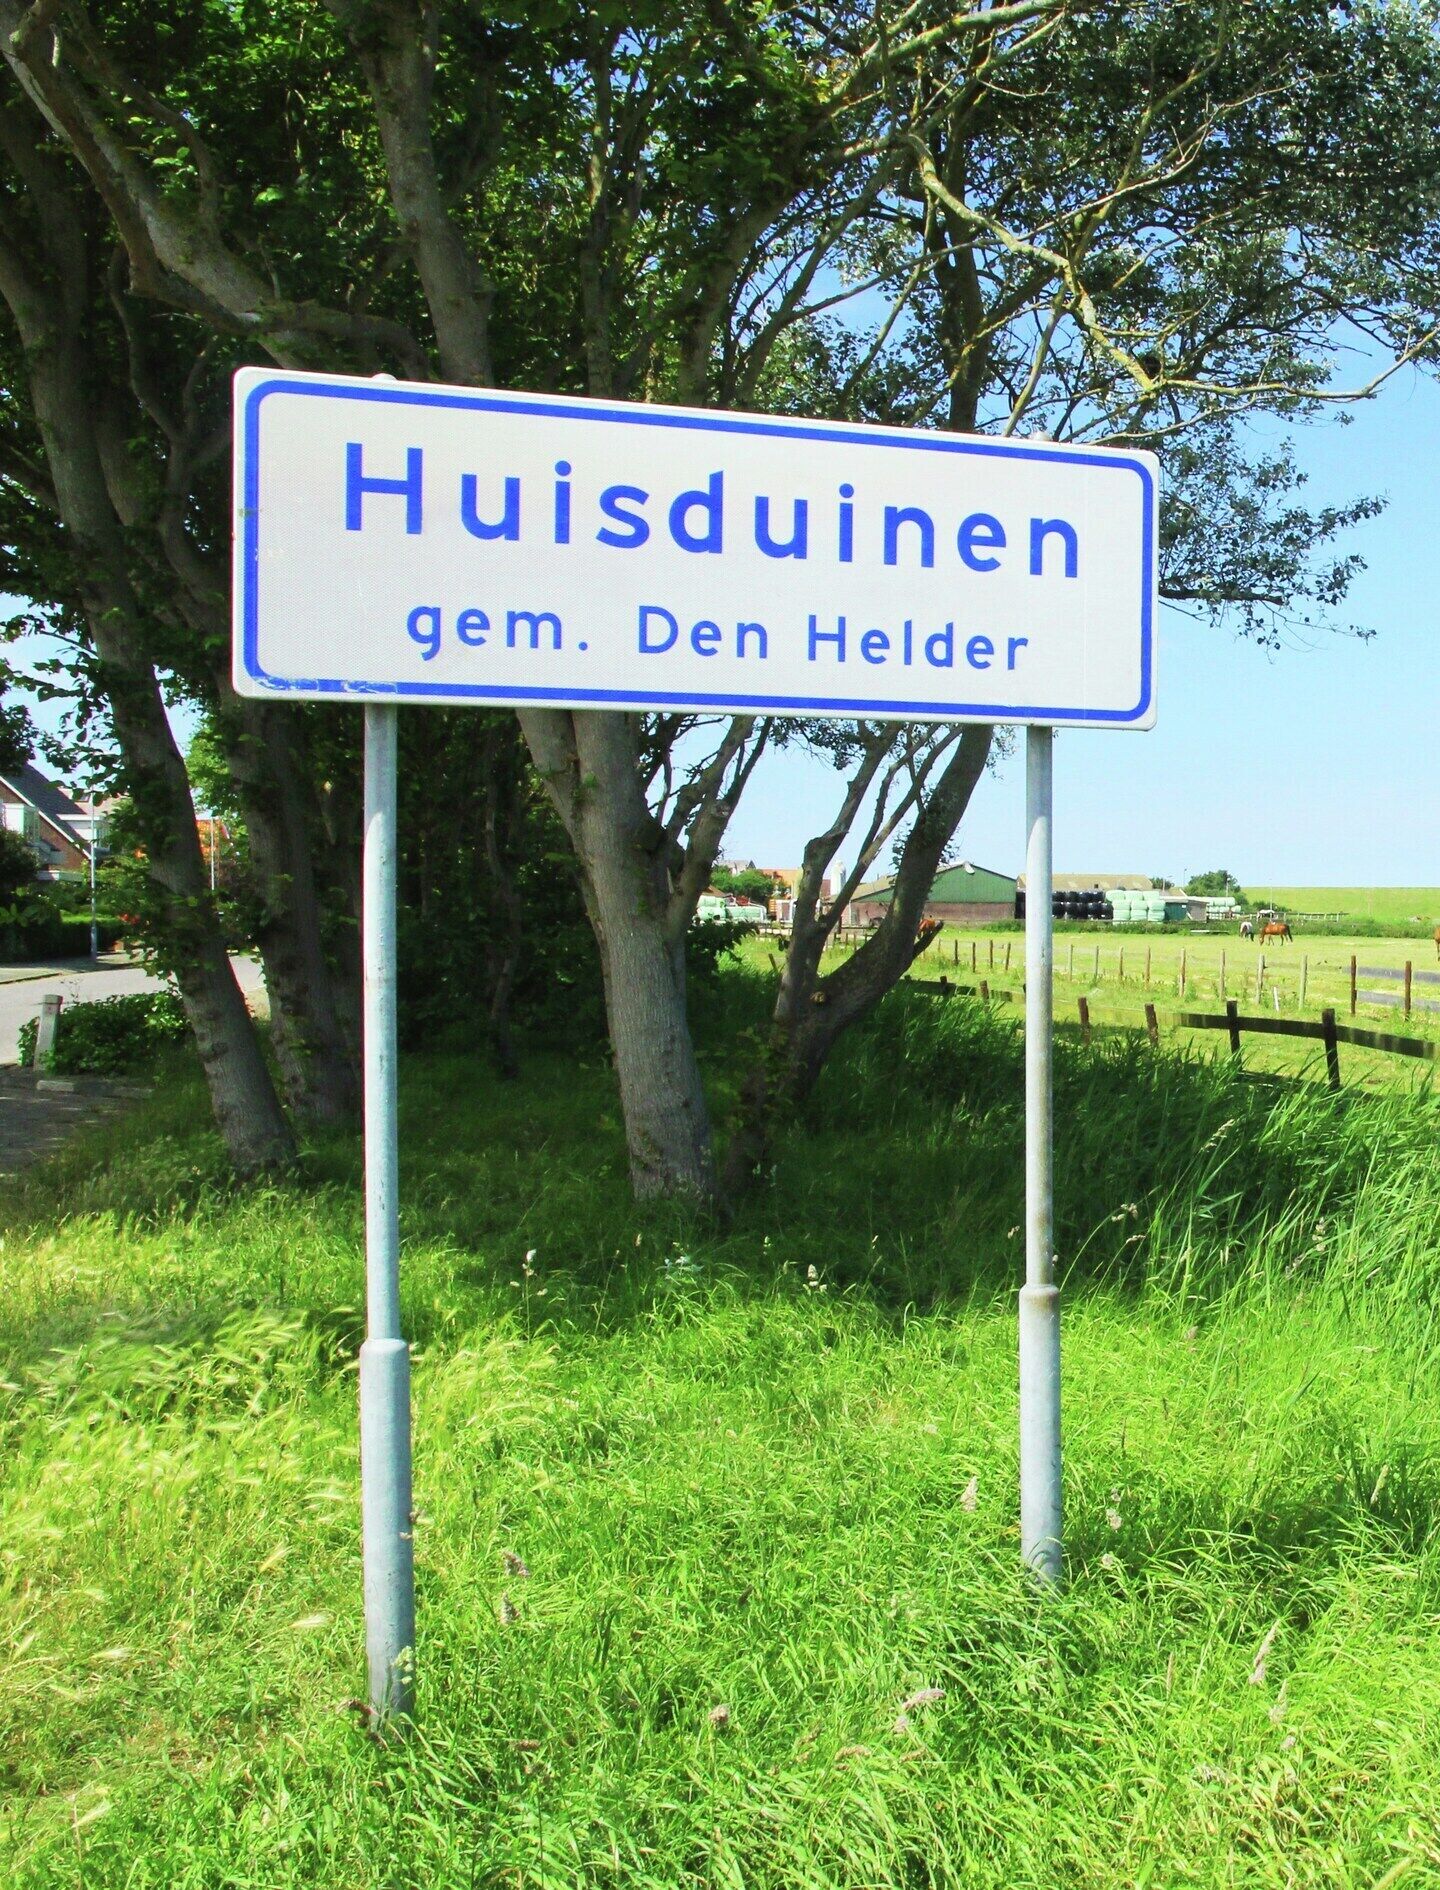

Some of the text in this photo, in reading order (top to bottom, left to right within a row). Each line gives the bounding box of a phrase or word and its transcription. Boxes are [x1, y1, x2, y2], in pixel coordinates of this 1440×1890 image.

[344, 441, 1079, 579] Huisduinen
[405, 604, 1029, 671] gem. Den Helder
